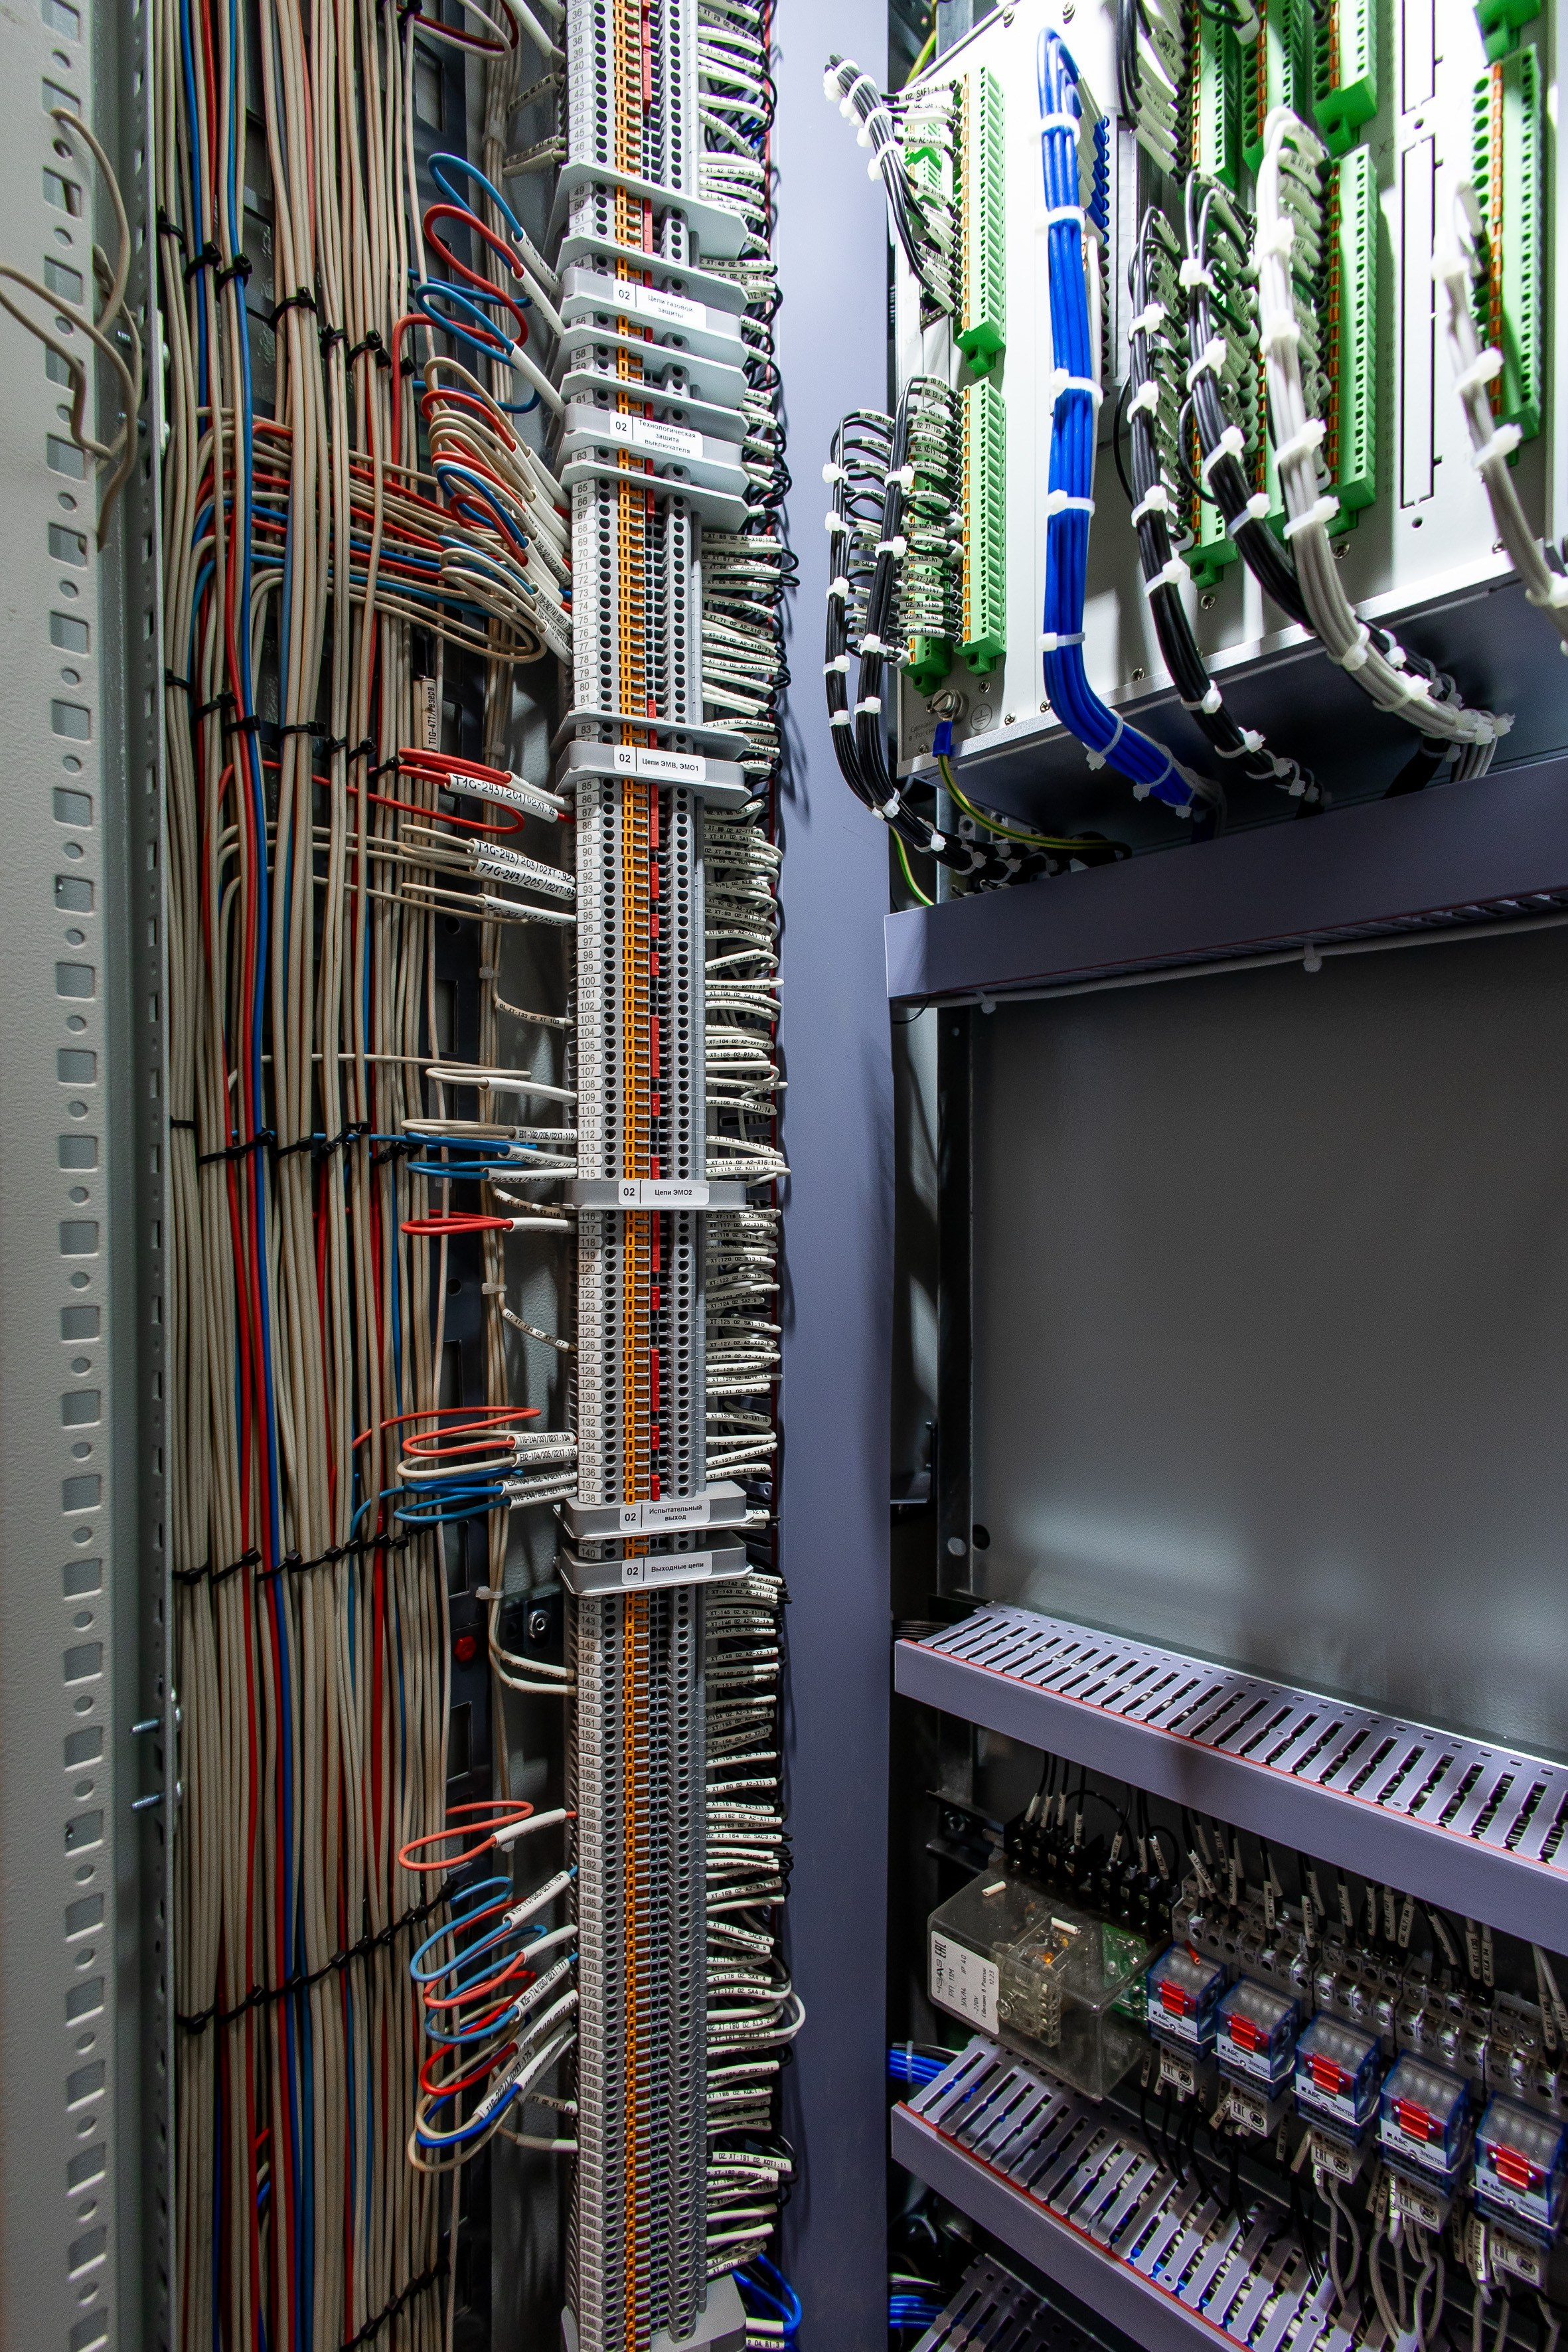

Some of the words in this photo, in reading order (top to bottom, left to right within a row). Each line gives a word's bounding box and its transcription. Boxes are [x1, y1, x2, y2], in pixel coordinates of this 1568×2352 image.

[572, 7, 582, 20] 36
[572, 35, 583, 47] 38
[574, 60, 584, 71] 40
[574, 88, 584, 98] 42
[574, 114, 584, 125] 44
[574, 142, 585, 152] 46
[574, 199, 585, 211] 50
[619, 289, 631, 300] 02
[648, 294, 665, 305] Цепи
[658, 307, 684, 319] защиты
[576, 349, 586, 360] 58
[615, 421, 627, 431] 02
[639, 420, 696, 438] Технологическая
[656, 433, 680, 443] защита
[645, 439, 690, 454] выключателя
[576, 451, 588, 461] 63
[578, 483, 588, 493] 65
[577, 497, 588, 507] 66
[578, 510, 588, 520] 67
[578, 523, 588, 534] 68
[578, 536, 588, 547] 69
[578, 548, 588, 558] 70
[579, 562, 588, 572] 71
[578, 575, 588, 585] 72
[578, 588, 589, 598] 73
[577, 601, 588, 611] 74
[578, 615, 589, 625] 75
[578, 628, 589, 639] 76
[579, 641, 589, 652] 77
[579, 655, 589, 665] 78
[579, 668, 589, 678] 79
[580, 681, 589, 692] 80
[580, 693, 589, 704] 81
[581, 725, 591, 734] 83
[619, 753, 631, 763] 02
[661, 761, 678, 769] ЭМВ,
[582, 781, 592, 791] 85
[582, 807, 592, 817] 87
[582, 834, 593, 843] 89
[583, 858, 592, 868] 91
[583, 884, 593, 894] 93
[583, 911, 593, 920] 95
[583, 937, 593, 947] 97
[583, 963, 593, 973] 99
[580, 989, 595, 998] 101
[580, 1014, 595, 1024] 103
[580, 1041, 595, 1050] 105
[580, 1067, 595, 1075] 107
[581, 1093, 595, 1102] 109
[580, 1119, 595, 1127] 111
[580, 1143, 595, 1152] 113
[580, 1169, 595, 1178] 115
[623, 1188, 635, 1196] 02
[581, 1251, 595, 1260] 119
[580, 1277, 595, 1286] 121
[581, 1327, 595, 1336] 125
[581, 1353, 595, 1362] 127
[581, 1379, 595, 1388] 129
[580, 1405, 595, 1414] 131
[581, 1429, 596, 1438] 133
[581, 1454, 596, 1464] 135
[581, 1480, 596, 1490] 137
[581, 1493, 596, 1503] 138
[649, 1504, 702, 1515] Испытательный
[625, 1512, 636, 1522] 02
[582, 1548, 595, 1557] 140
[627, 1567, 639, 1576] 02
[581, 1603, 595, 1612] 142
[581, 1730, 595, 1741] 152
[581, 1757, 595, 1766] 154
[582, 1782, 596, 1792] 156
[582, 1807, 596, 1818] 158
[961, 1954, 967, 1964] 40
